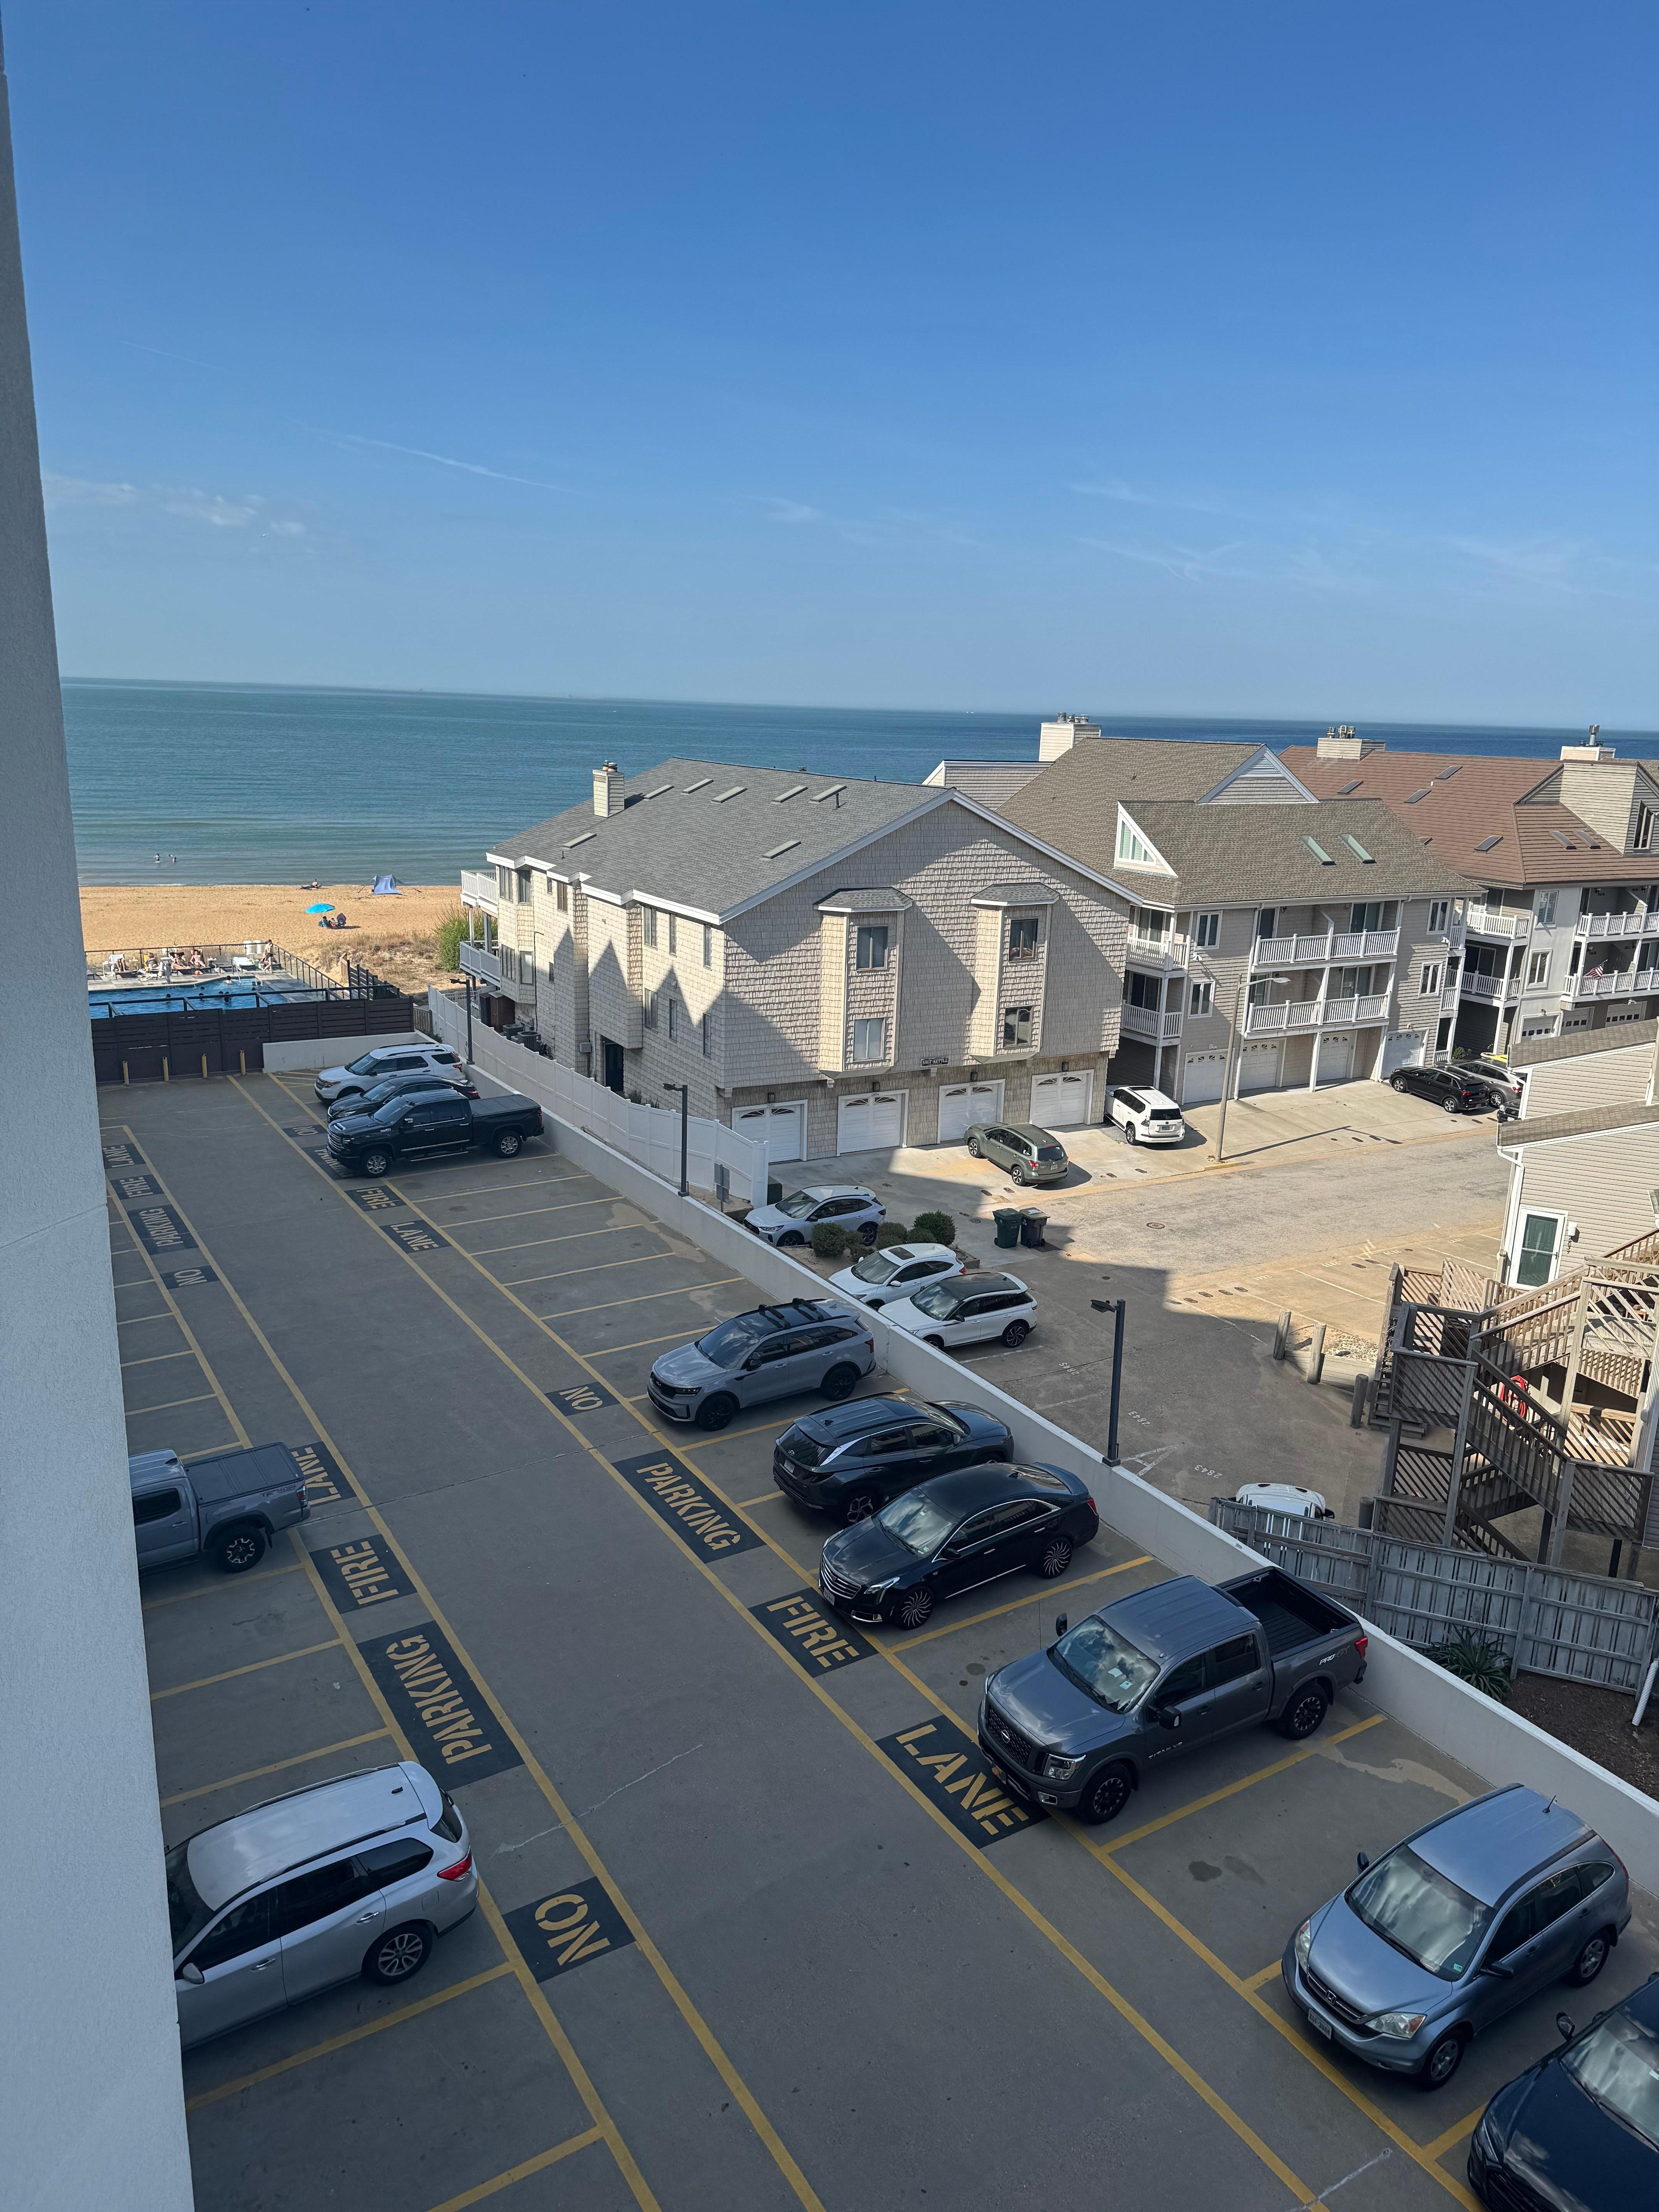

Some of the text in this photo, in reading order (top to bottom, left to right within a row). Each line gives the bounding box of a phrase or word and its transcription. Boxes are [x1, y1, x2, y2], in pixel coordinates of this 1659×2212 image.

[102, 1145, 207, 1286] NO PARKING FIRE LANE
[292, 1126, 319, 1135] NO
[356, 1188, 397, 1209] FIRE
[390, 1222, 439, 1251] LANE
[1058, 1362, 1079, 1375] 2845
[1128, 1411, 1151, 1426] 2843
[1195, 1465, 1223, 1478] 2843
[559, 1386, 1029, 1836] NO PARKING FIRE LANE
[291, 1447, 610, 1965] NO PARKING FIRE LANE
